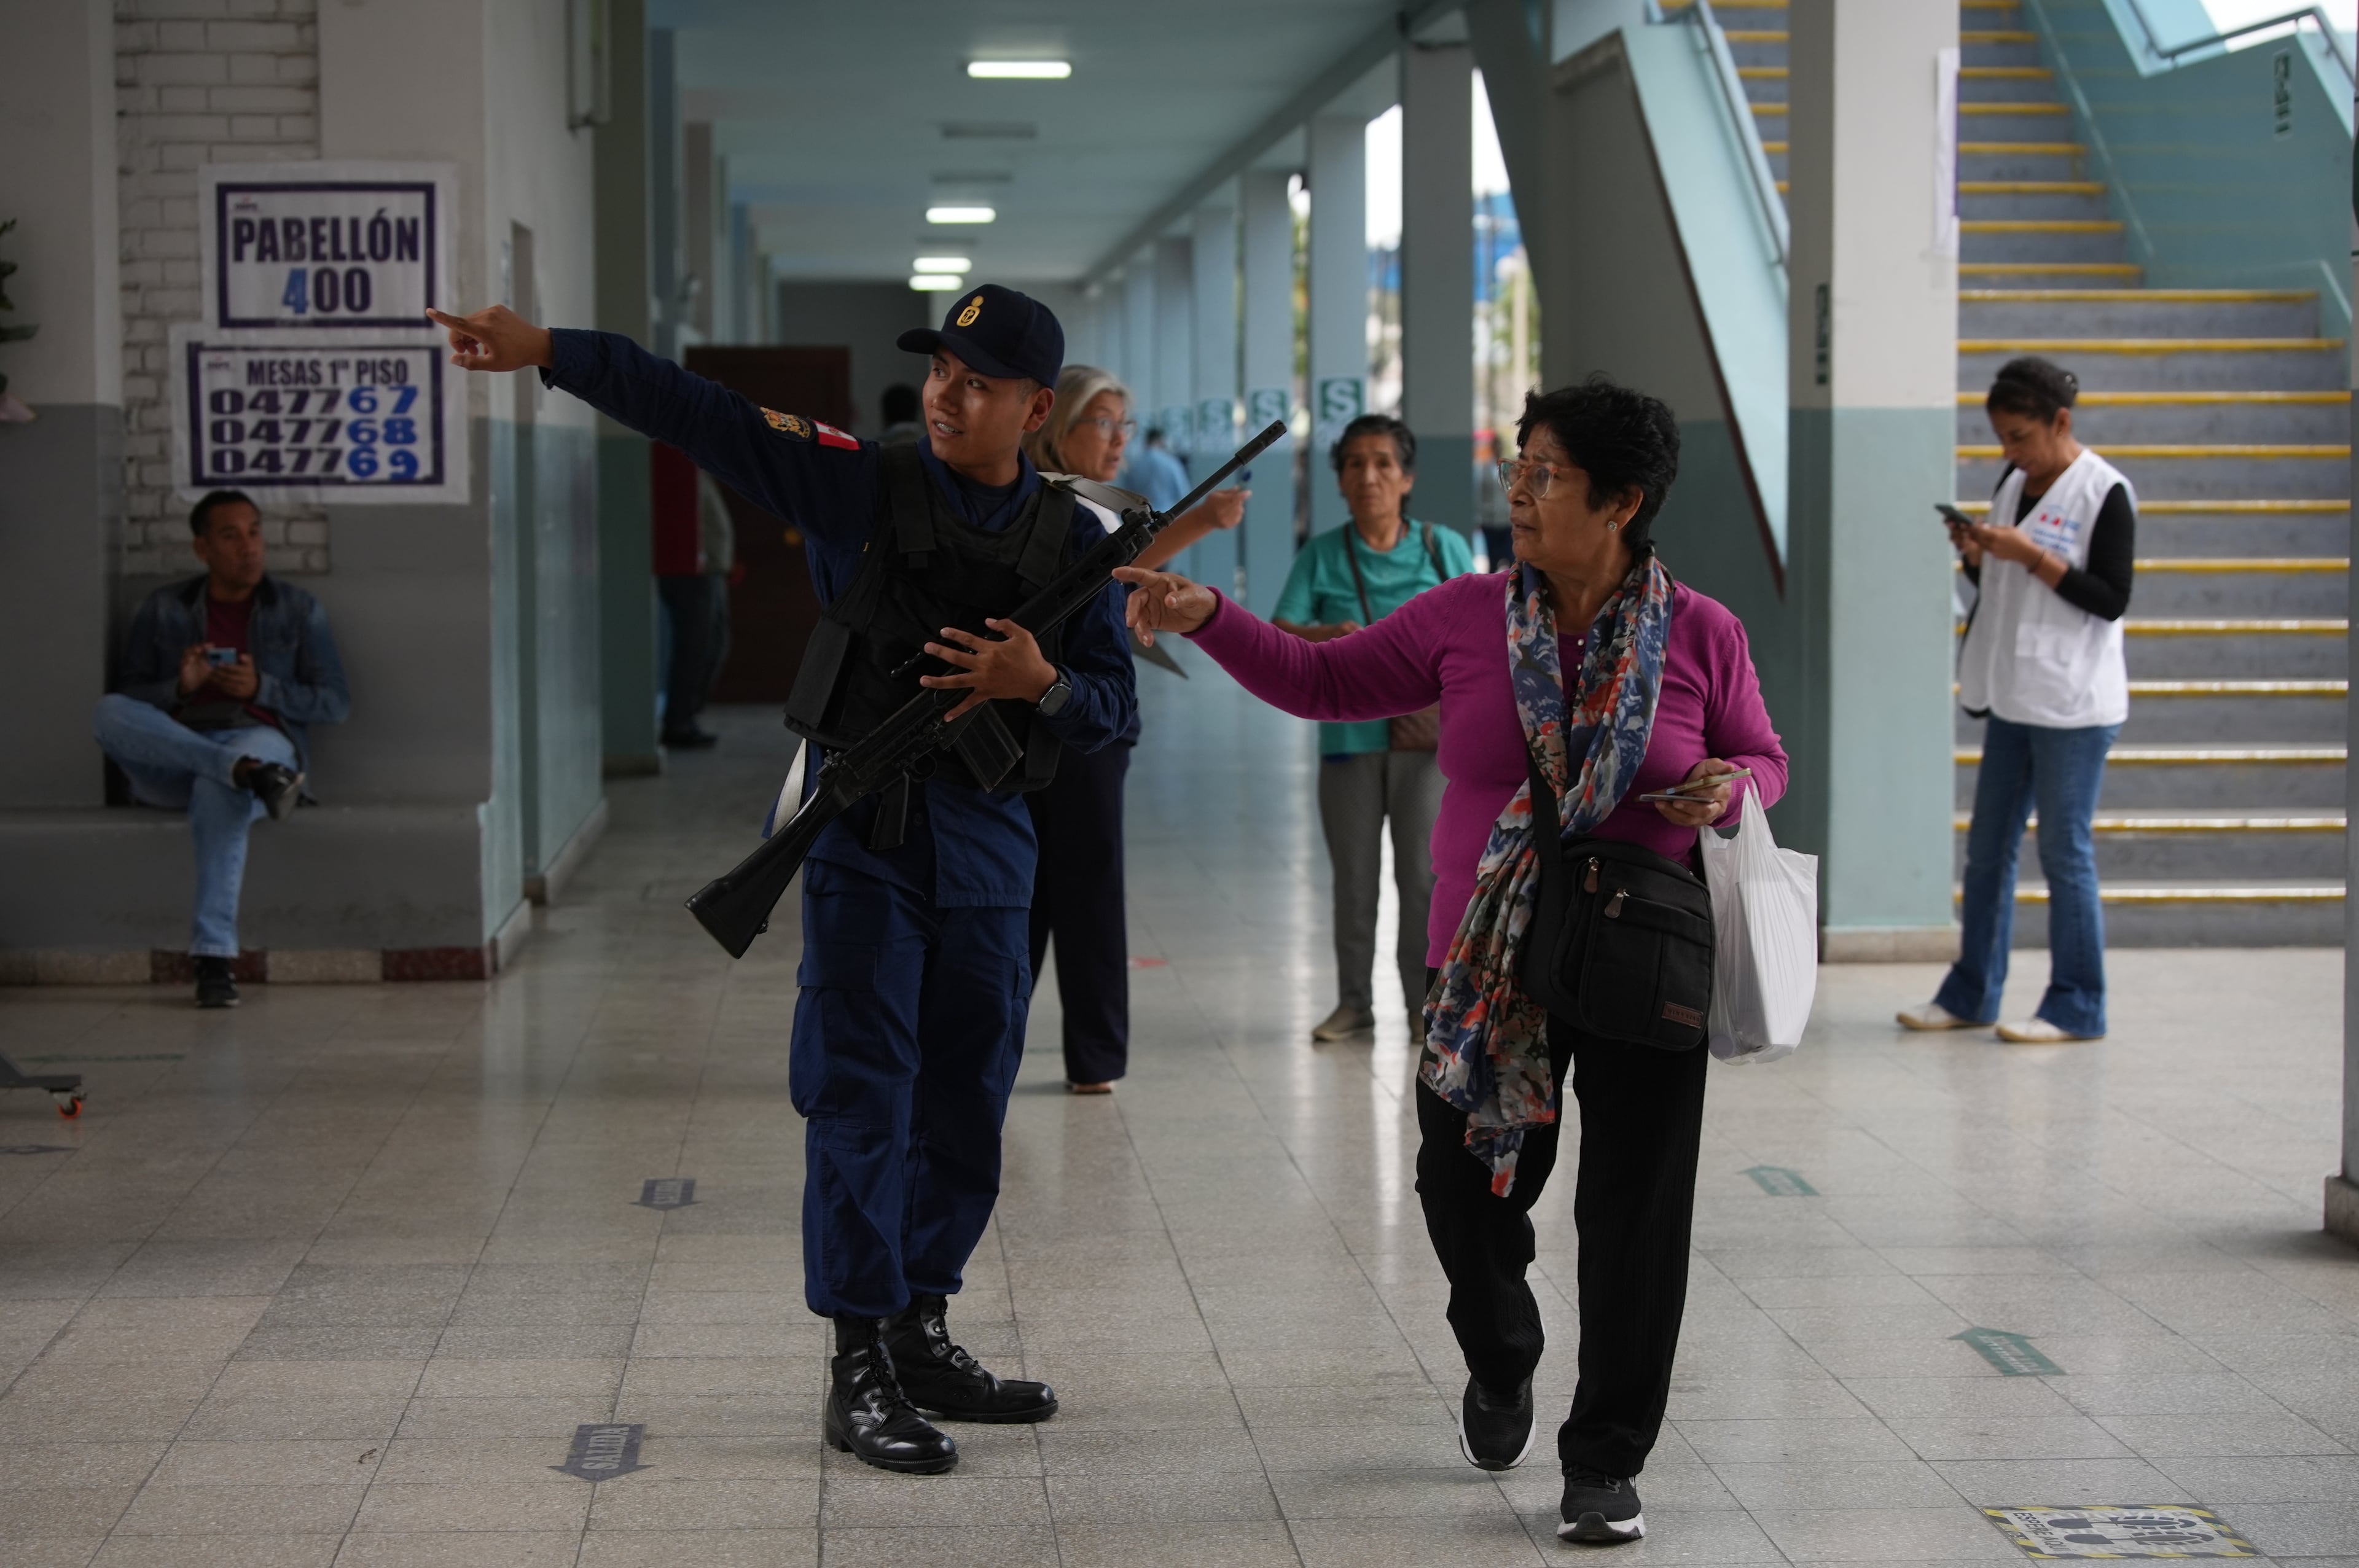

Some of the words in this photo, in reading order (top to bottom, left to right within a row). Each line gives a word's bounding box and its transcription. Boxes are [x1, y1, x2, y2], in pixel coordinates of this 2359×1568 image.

[232, 208, 420, 263] PABELLÓN
[281, 266, 372, 314] 400
[246, 360, 322, 385] MESAS
[356, 359, 409, 385] PISO
[209, 385, 418, 415] 047767
[1325, 380, 1357, 423] S
[210, 417, 418, 445] 047768
[211, 447, 419, 480] 047769
[581, 1426, 630, 1470] SALIDA
[2013, 1512, 2054, 1535] ESPERE
[2038, 1535, 2078, 1551] AQUÍ
